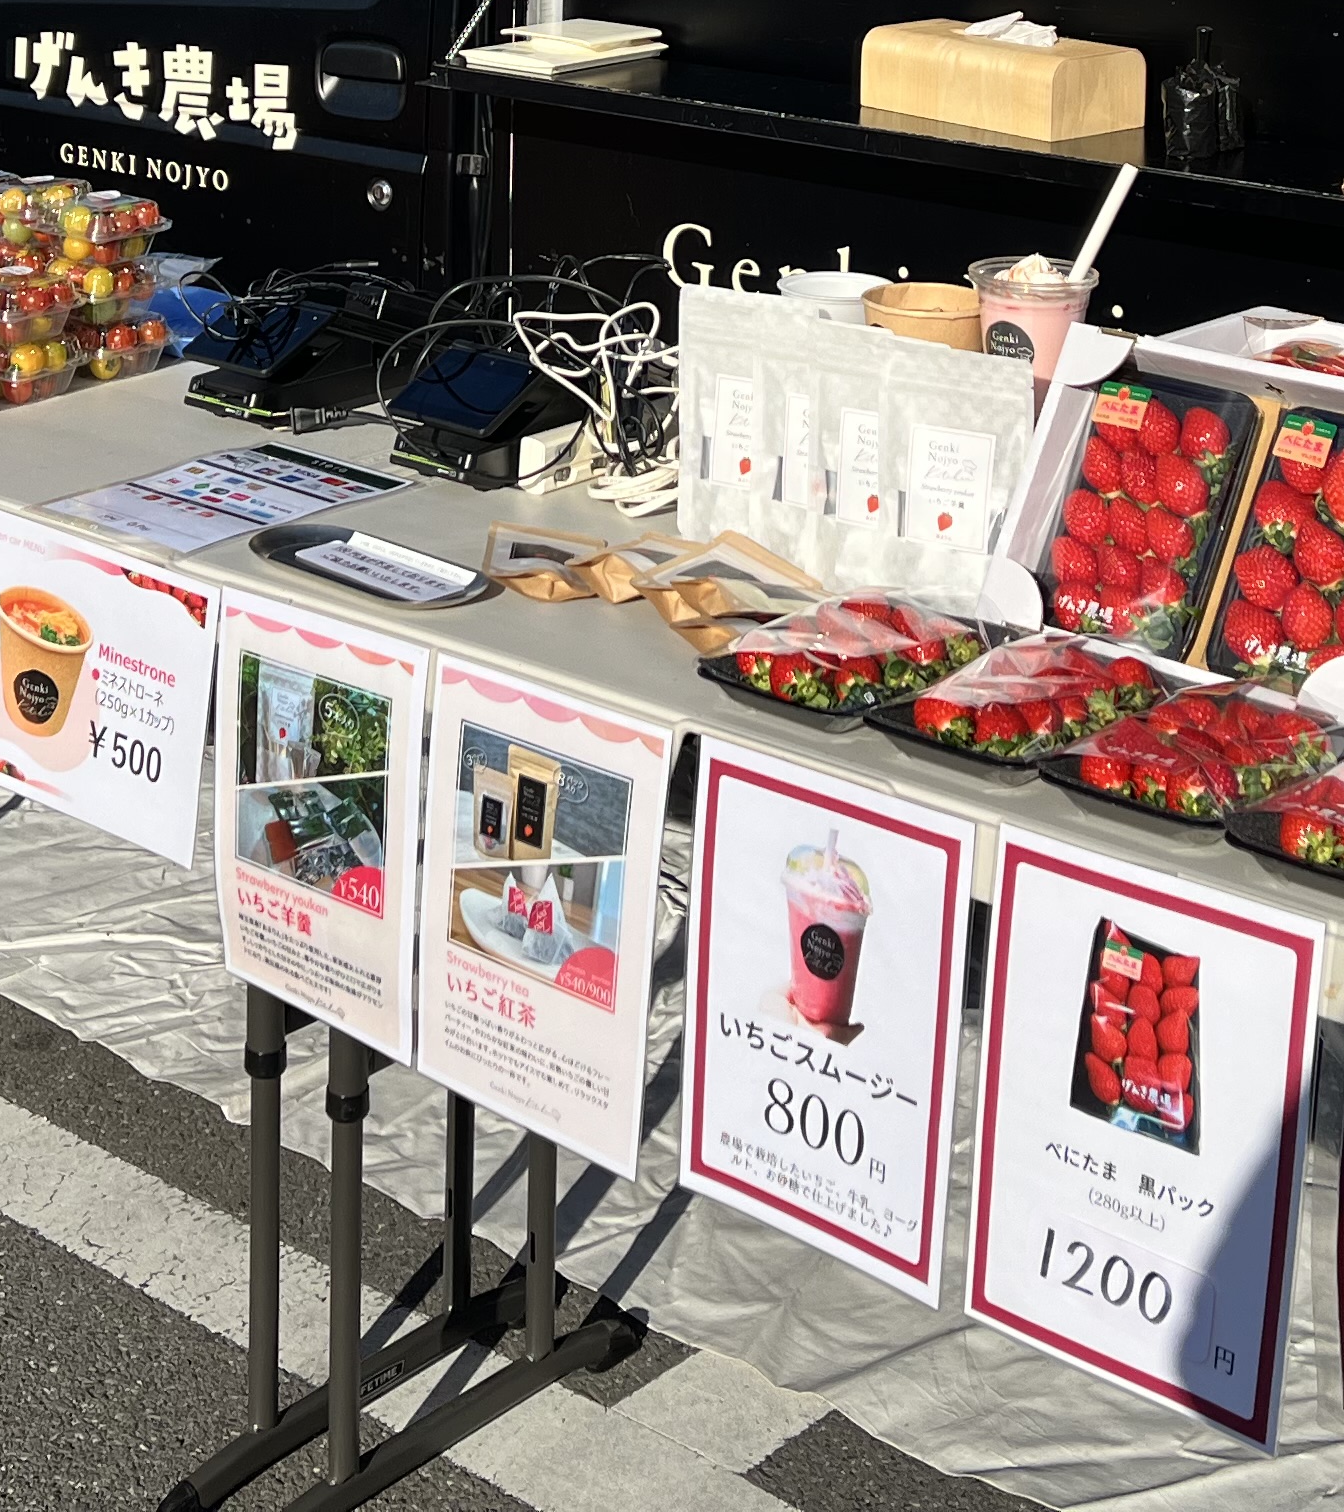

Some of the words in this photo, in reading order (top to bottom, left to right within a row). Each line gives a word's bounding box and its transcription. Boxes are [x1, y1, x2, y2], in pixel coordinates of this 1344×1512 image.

[12, 31, 298, 152] げんき農場
[60, 141, 139, 178] GENKI
[146, 153, 231, 193] NOJYO
[992, 330, 1019, 344] Genki
[1100, 400, 1140, 417] べにたま
[1282, 434, 1324, 453] べにたま
[97, 642, 177, 689] Minestrone
[101, 668, 165, 706] ミネストローネ
[235, 867, 290, 902] Strawberry
[291, 893, 329, 918] youkan
[446, 950, 509, 989] Strawberry
[511, 980, 530, 999] tea
[446, 971, 537, 1030] いちご紅茶
[718, 1011, 919, 1109] いちごスムージー
[762, 1076, 865, 1169] 800
[869, 1156, 886, 1185] 円
[1045, 1141, 1119, 1186] べにたま
[1138, 1171, 1218, 1220] 黒パック
[1039, 1226, 1174, 1326] 1200
[1212, 1343, 1237, 1378] 円
